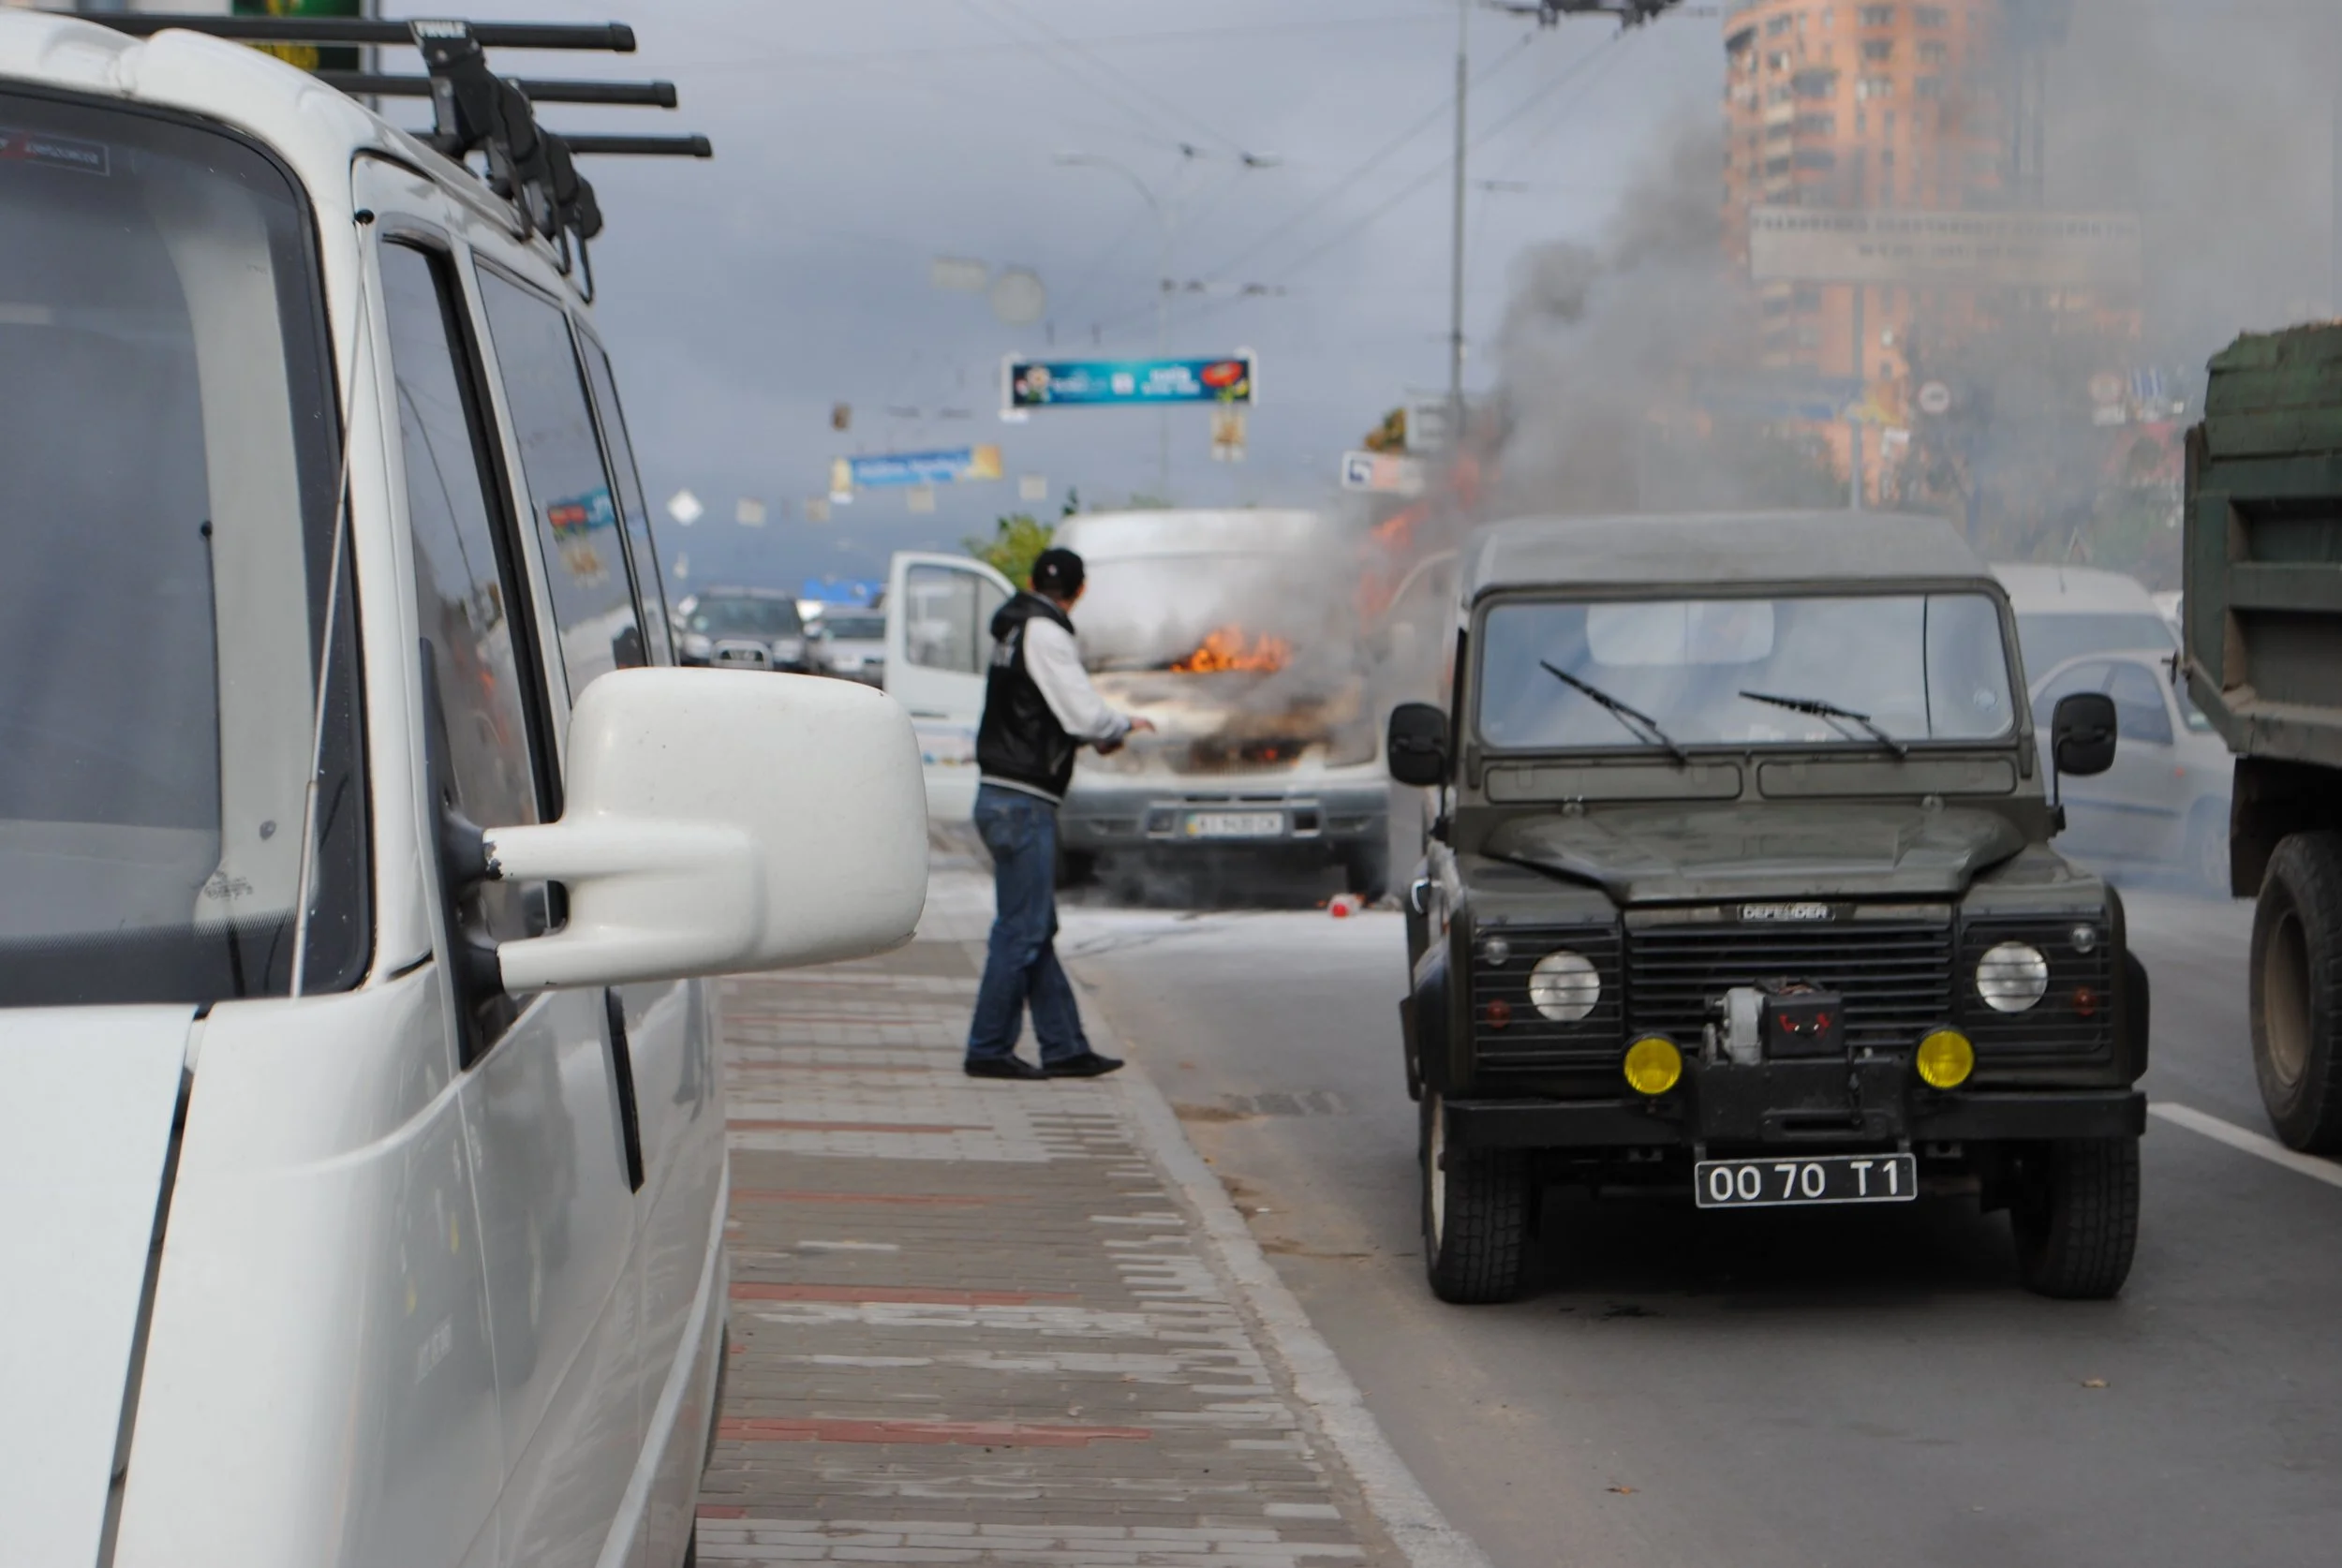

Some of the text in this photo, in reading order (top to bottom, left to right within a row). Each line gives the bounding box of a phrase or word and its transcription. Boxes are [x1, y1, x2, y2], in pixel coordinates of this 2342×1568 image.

[1743, 902, 1828, 920] DEFENDER
[1774, 1162, 1826, 1199] 70
[1850, 1160, 1898, 1196] T1
